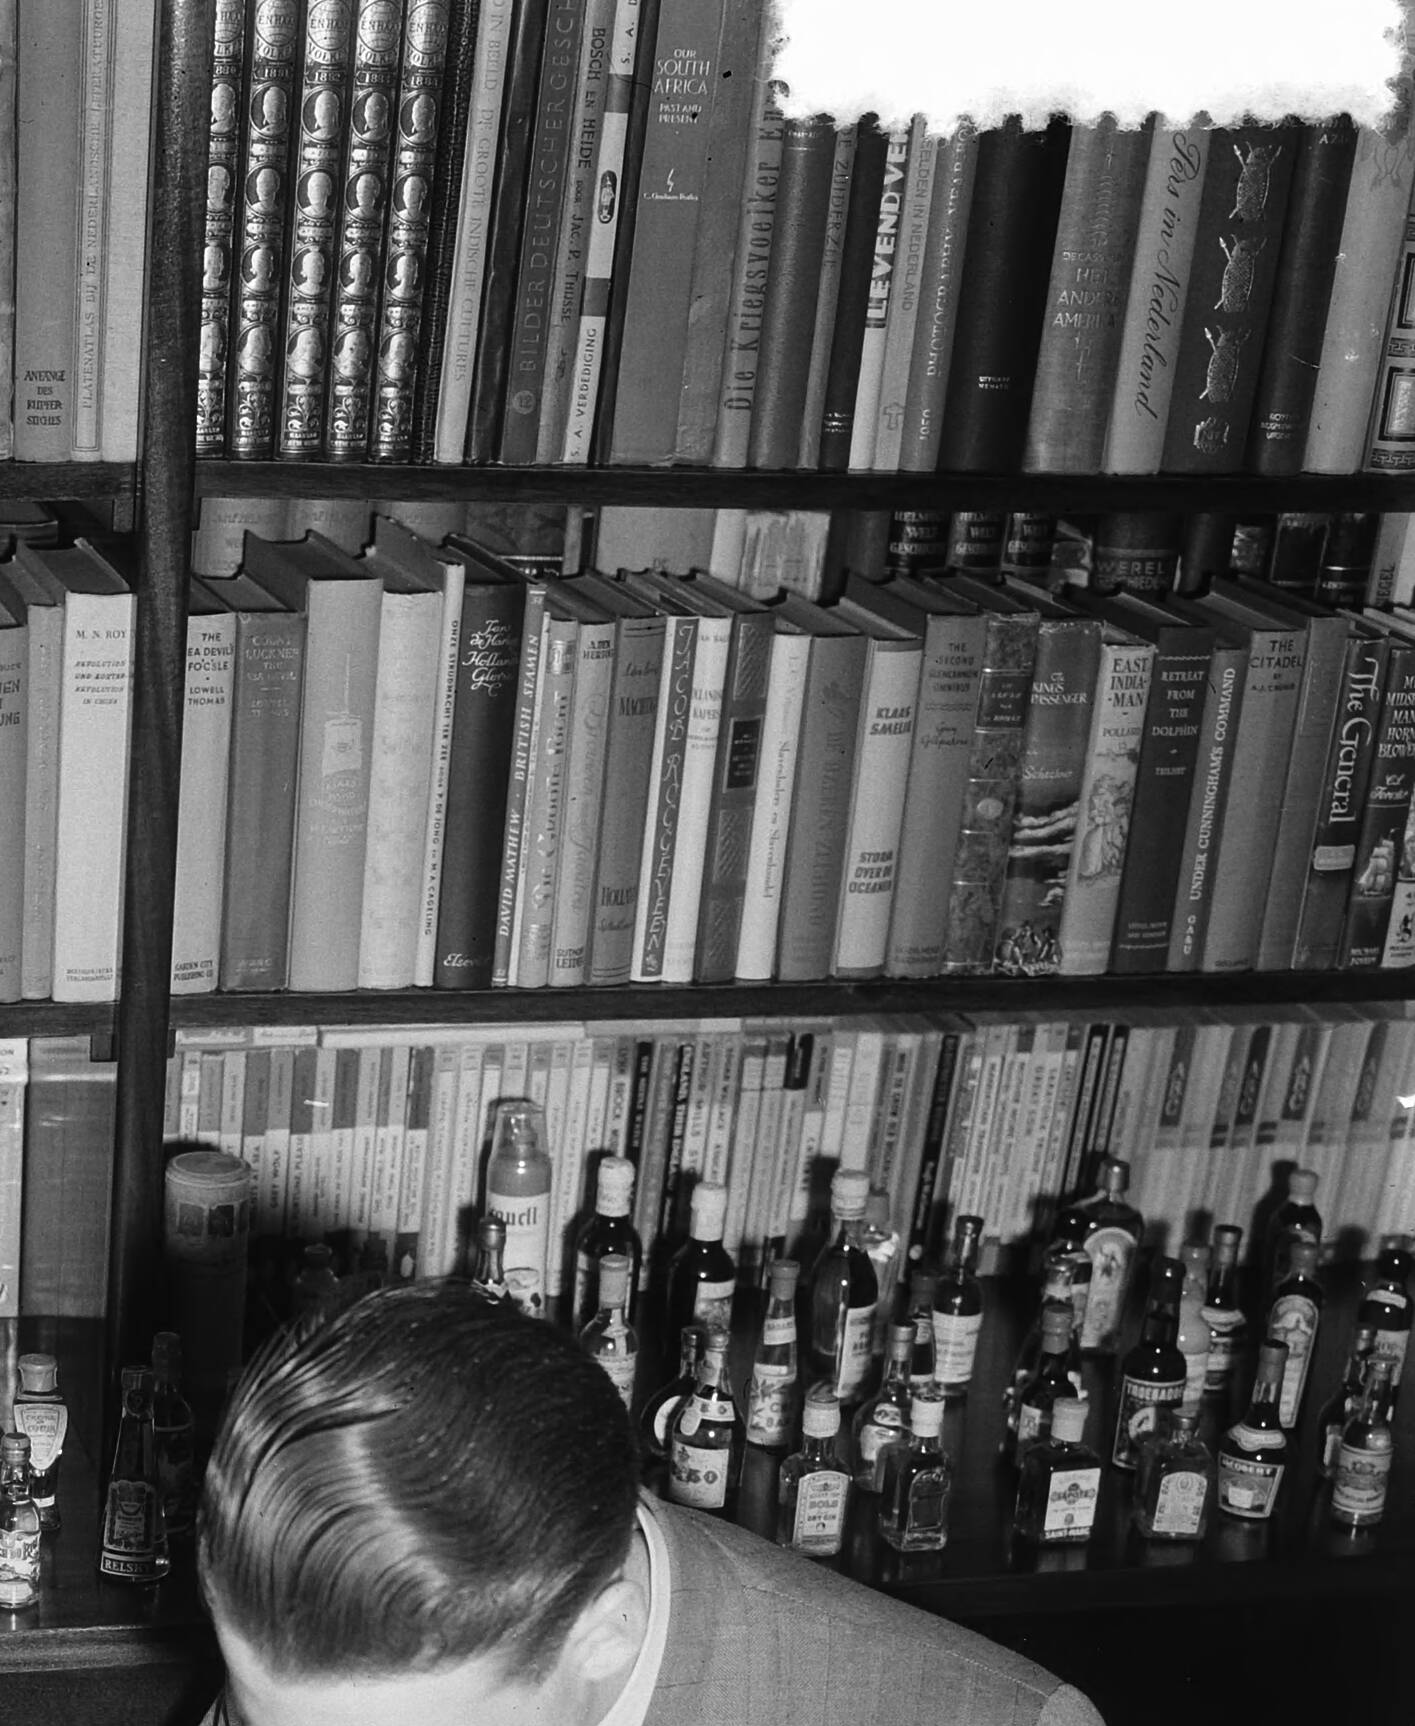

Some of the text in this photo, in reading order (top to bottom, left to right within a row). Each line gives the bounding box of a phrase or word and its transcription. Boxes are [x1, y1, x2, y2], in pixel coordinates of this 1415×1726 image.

[588, 27, 606, 81] BOSCH
[657, 59, 710, 77] SOUTH
[674, 49, 696, 58] OUR
[654, 77, 708, 95] AFRICA
[577, 118, 596, 169] HEIDE
[1171, 133, 1201, 200] Pers
[867, 192, 901, 320] LEVEND
[902, 204, 926, 312] IN NEDERLAND
[724, 370, 756, 412] Die
[201, 632, 222, 643] THE
[1269, 639, 1294, 654] THE
[1112, 657, 1150, 673] EAST
[1250, 654, 1303, 669] CITADEL
[189, 686, 225, 696] LOWELL
[500, 634, 539, 937] DAVID MATHEW BRITISH SEAMEN
[1190, 853, 1206, 901] UNDER
[1214, 667, 1236, 742] COMMAND
